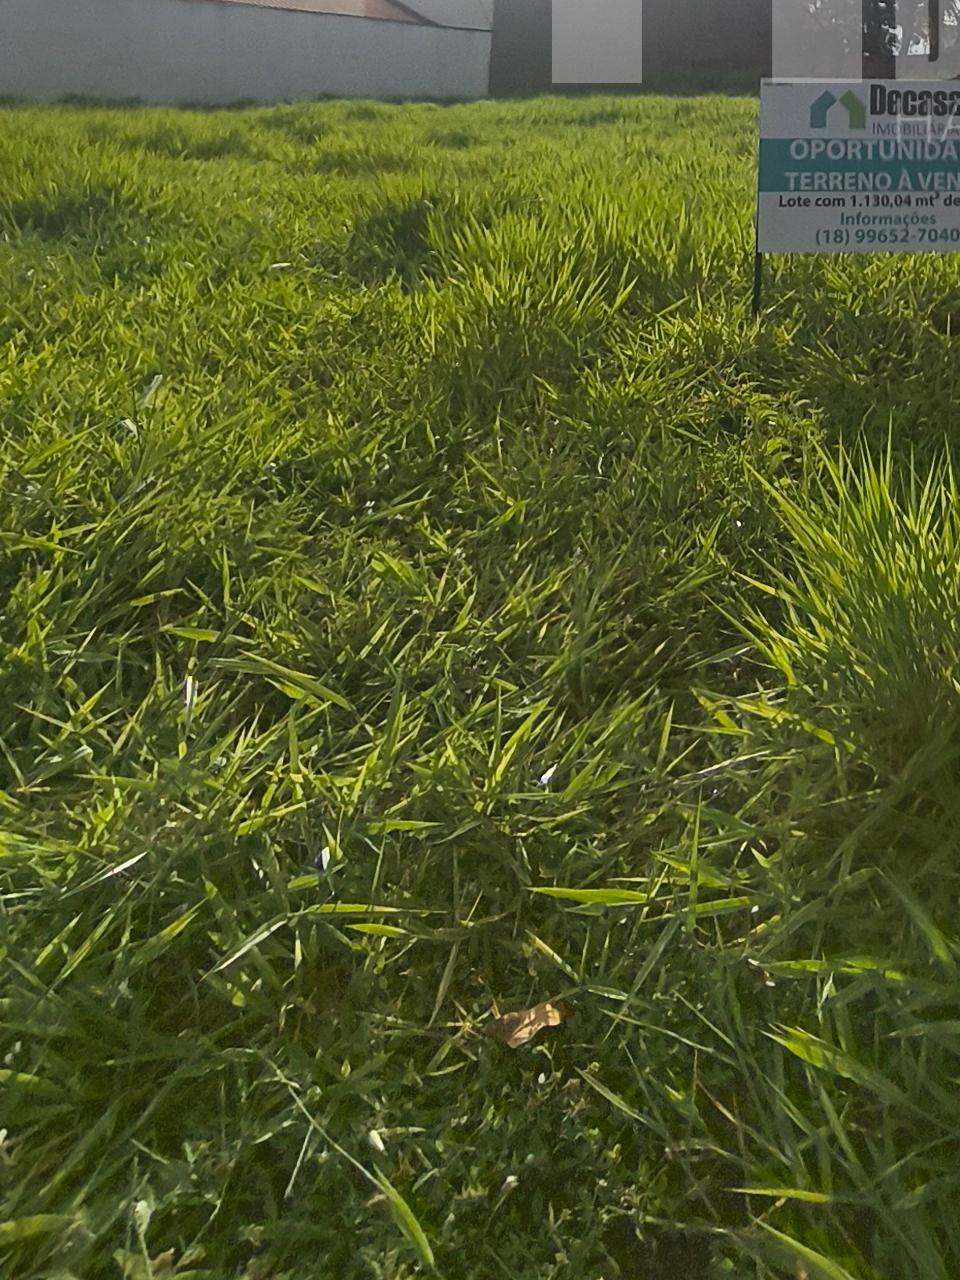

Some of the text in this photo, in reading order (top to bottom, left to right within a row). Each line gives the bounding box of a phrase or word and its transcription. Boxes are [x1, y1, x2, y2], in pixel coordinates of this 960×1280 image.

[786, 172, 891, 191] TERRENO
[779, 195, 811, 208] Lote
[815, 197, 845, 208] com
[850, 195, 912, 209] 1.130,04
[943, 195, 960, 206] de
[840, 212, 936, 228] Informações
[816, 229, 960, 245] (18) 99652-7040
